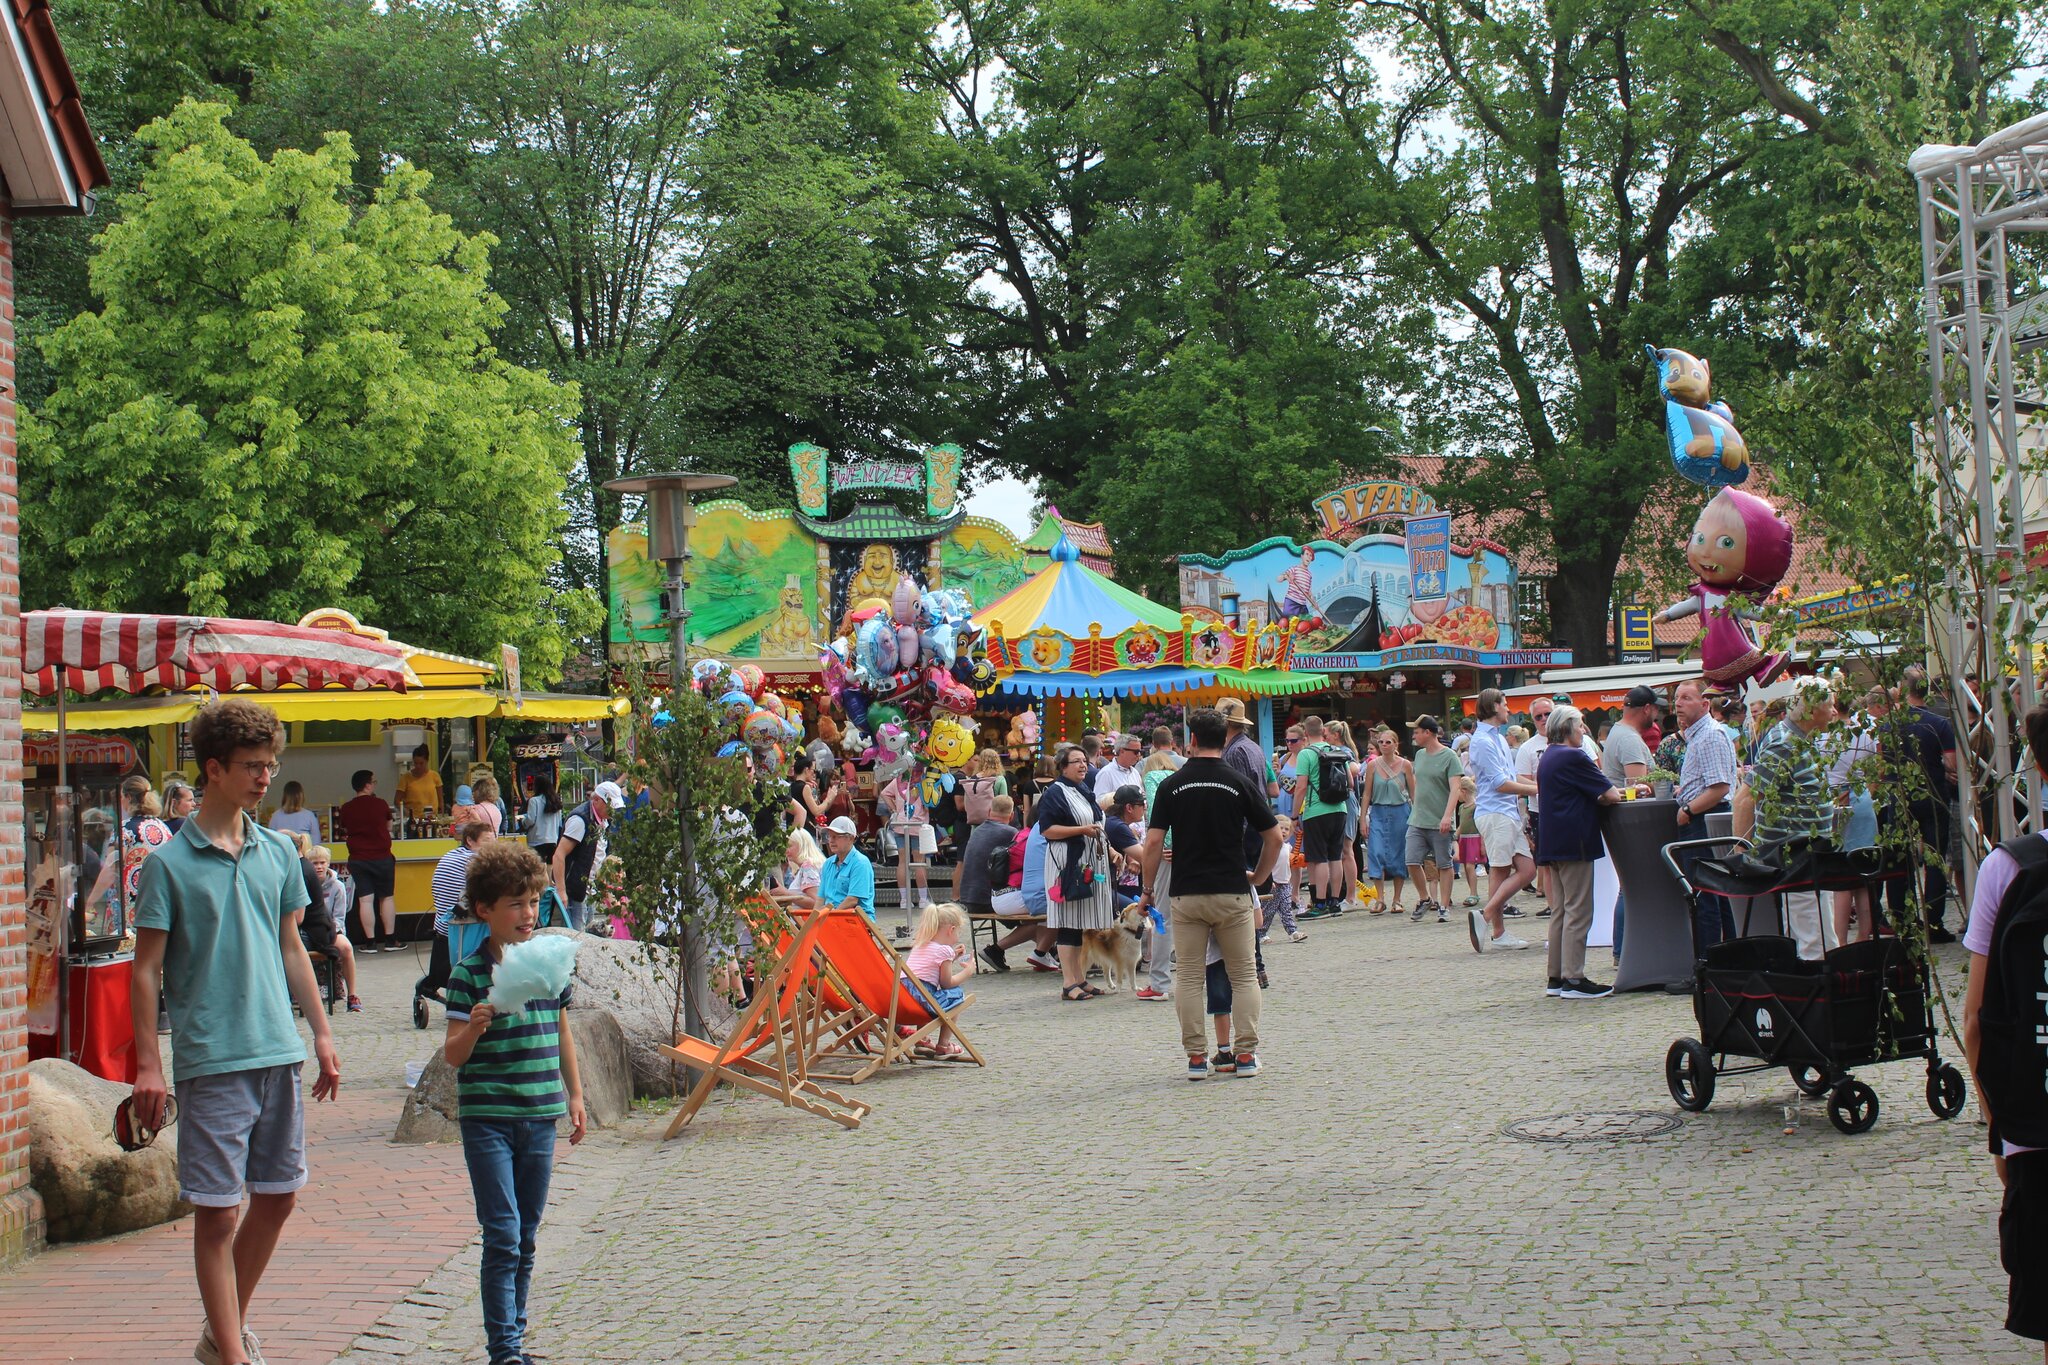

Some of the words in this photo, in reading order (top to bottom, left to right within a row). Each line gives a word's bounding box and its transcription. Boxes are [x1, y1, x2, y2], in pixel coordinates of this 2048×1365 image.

[834, 464, 917, 487] WENDLER
[1412, 548, 1446, 574] Pizza
[1292, 655, 1359, 669] MARGHERITA
[1380, 647, 1481, 666] STEINBAUER
[1500, 652, 1553, 666] THUNFISCH
[1623, 655, 1651, 664] Dalinger
